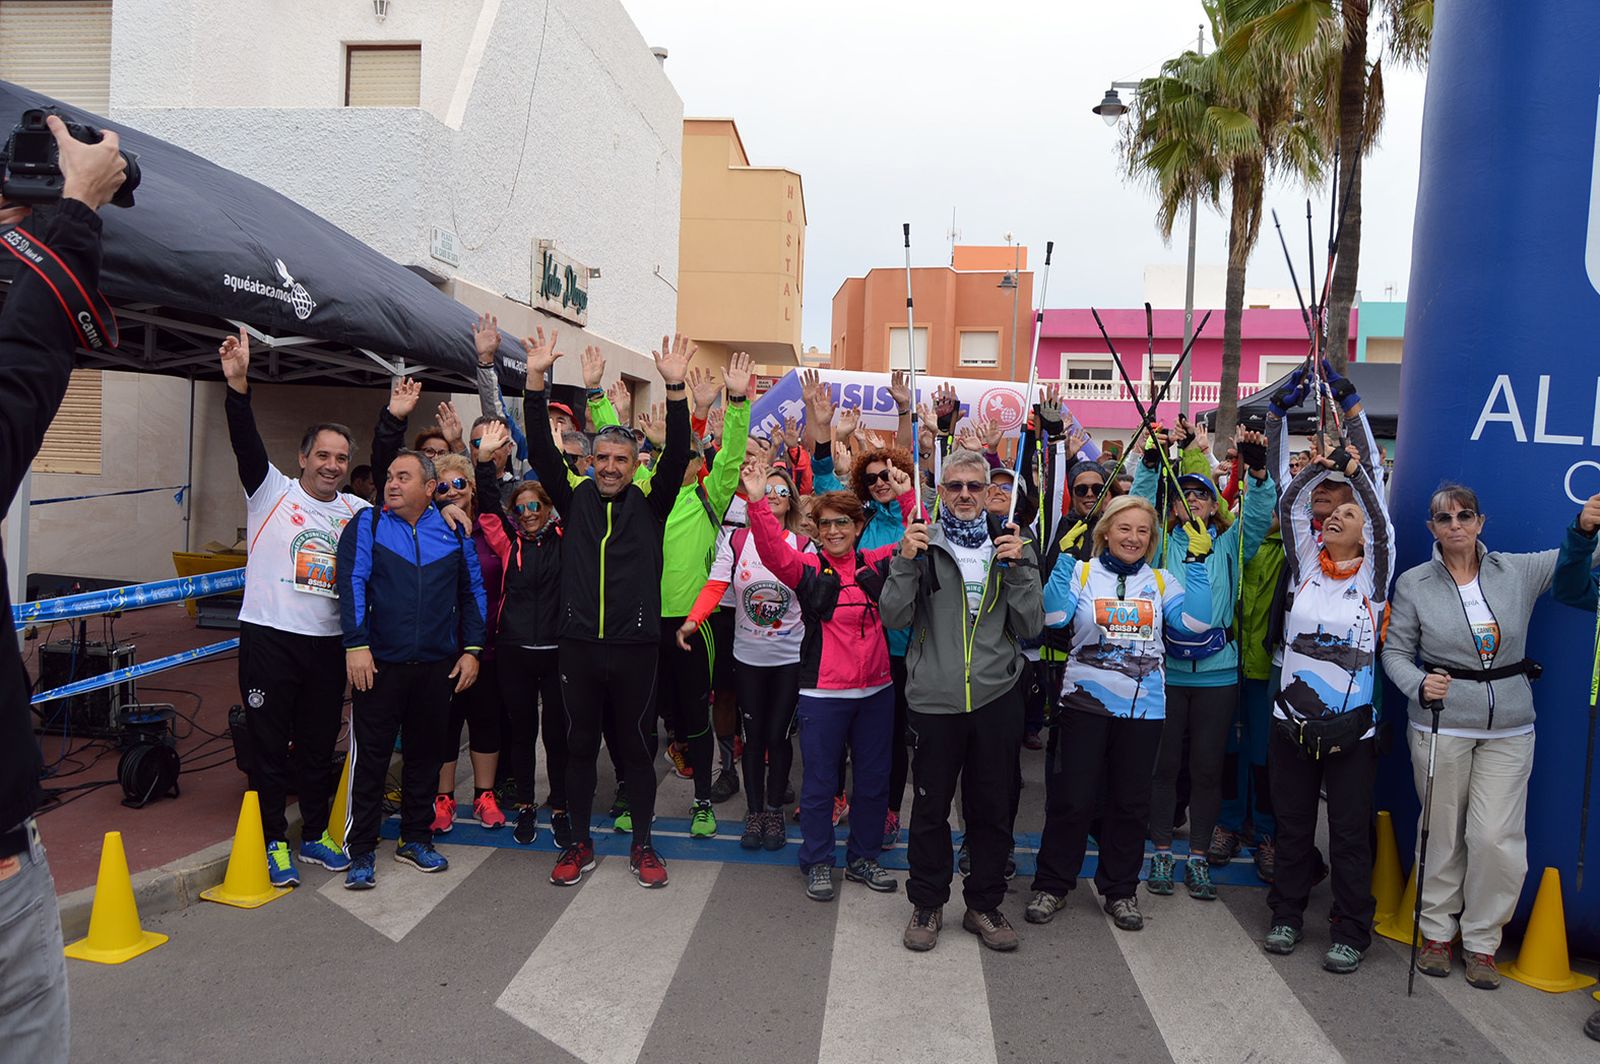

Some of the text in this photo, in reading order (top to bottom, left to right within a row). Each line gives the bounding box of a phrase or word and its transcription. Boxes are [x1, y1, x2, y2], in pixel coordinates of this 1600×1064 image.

[3, 230, 22, 246] EOS
[784, 185, 794, 321] HOSTAL
[223, 274, 292, 303] aquéatacamos
[306, 562, 335, 581] 776
[1105, 607, 1139, 624] 704
